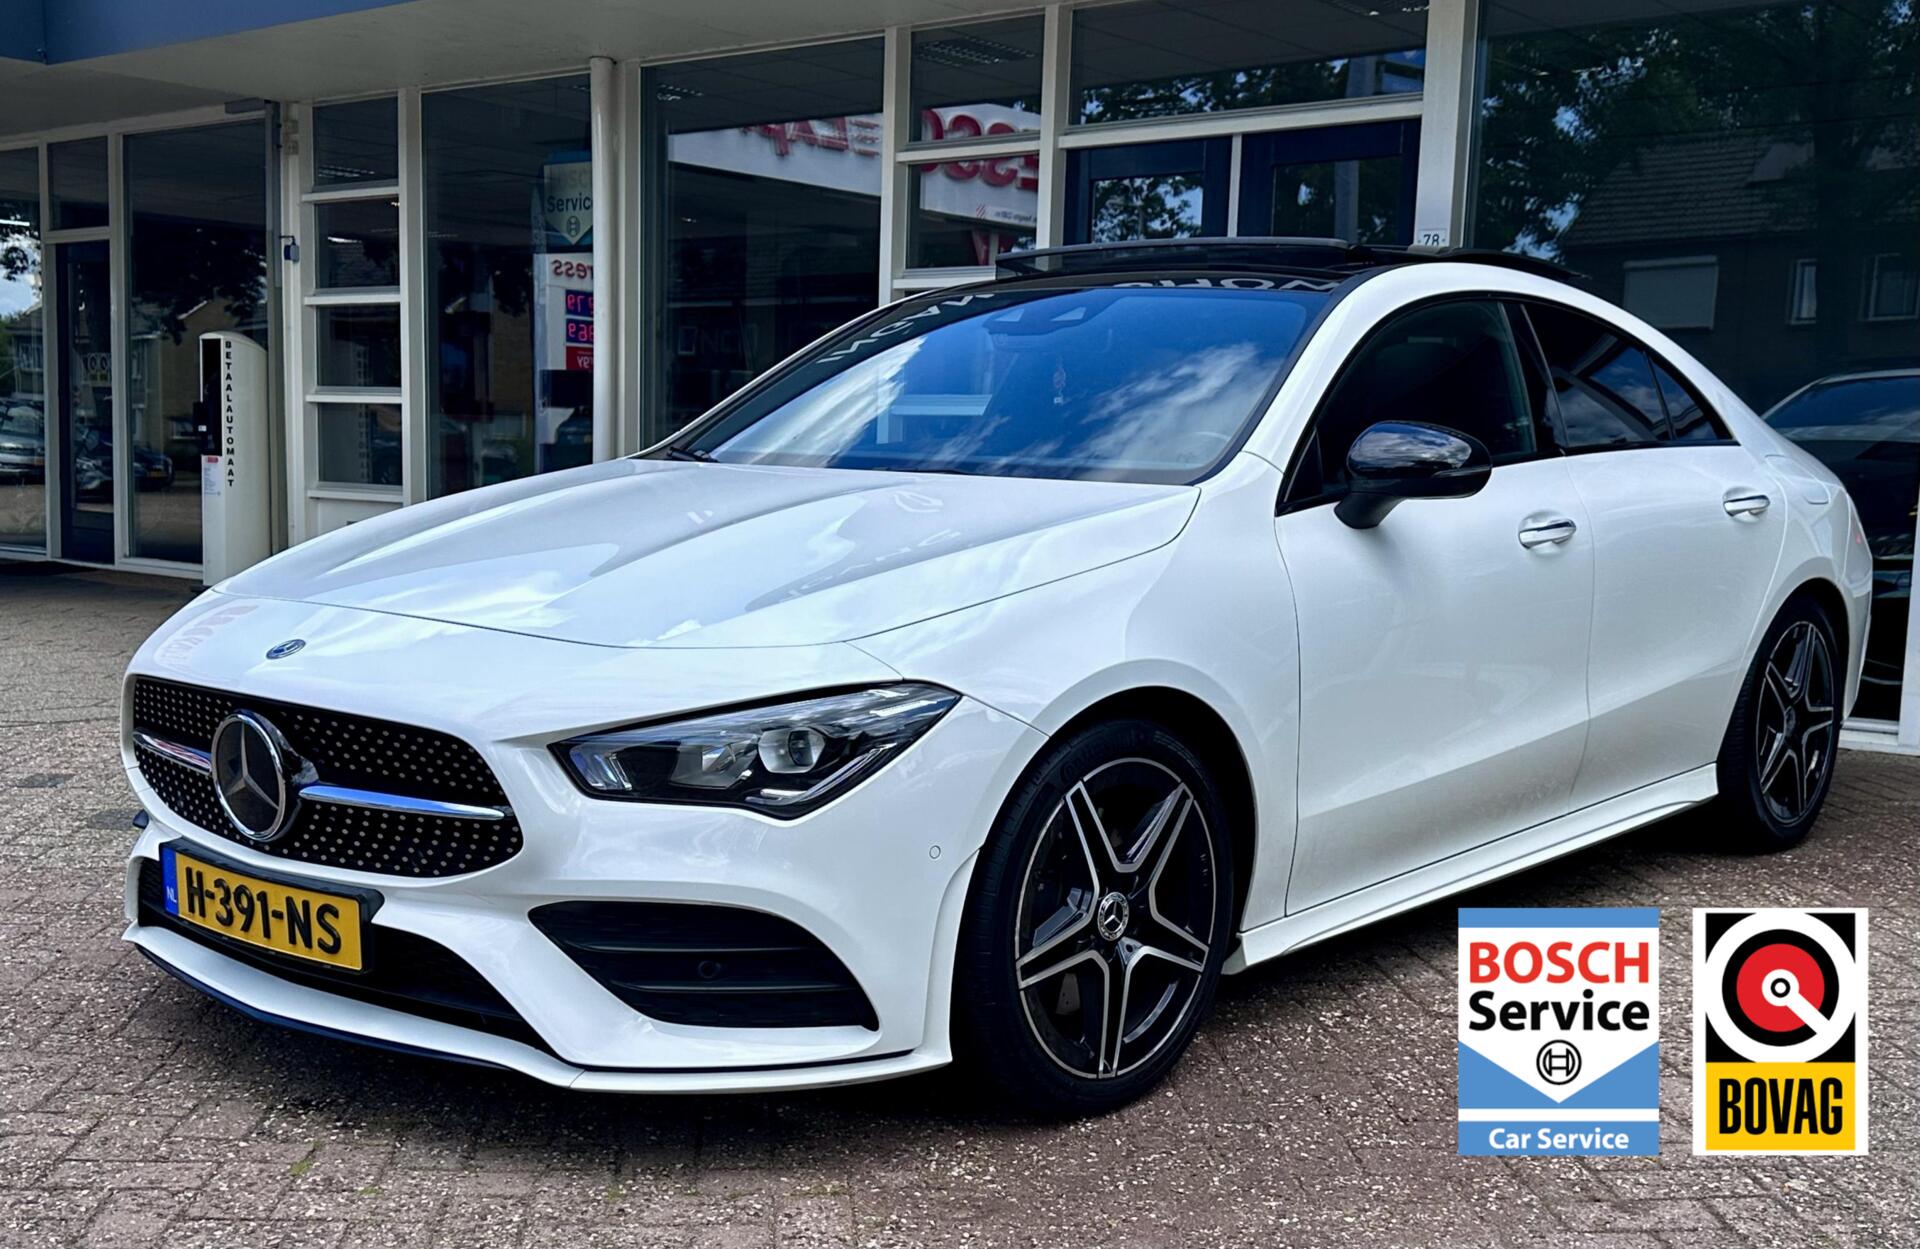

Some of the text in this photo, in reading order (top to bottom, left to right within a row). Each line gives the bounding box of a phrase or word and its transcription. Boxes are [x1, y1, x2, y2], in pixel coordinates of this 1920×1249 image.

[547, 193, 593, 213] Servic
[1423, 233, 1440, 246] 78
[225, 341, 235, 487] BETAALAUTOMAAT
[166, 886, 178, 903] NL
[185, 866, 342, 955] H-391-NS
